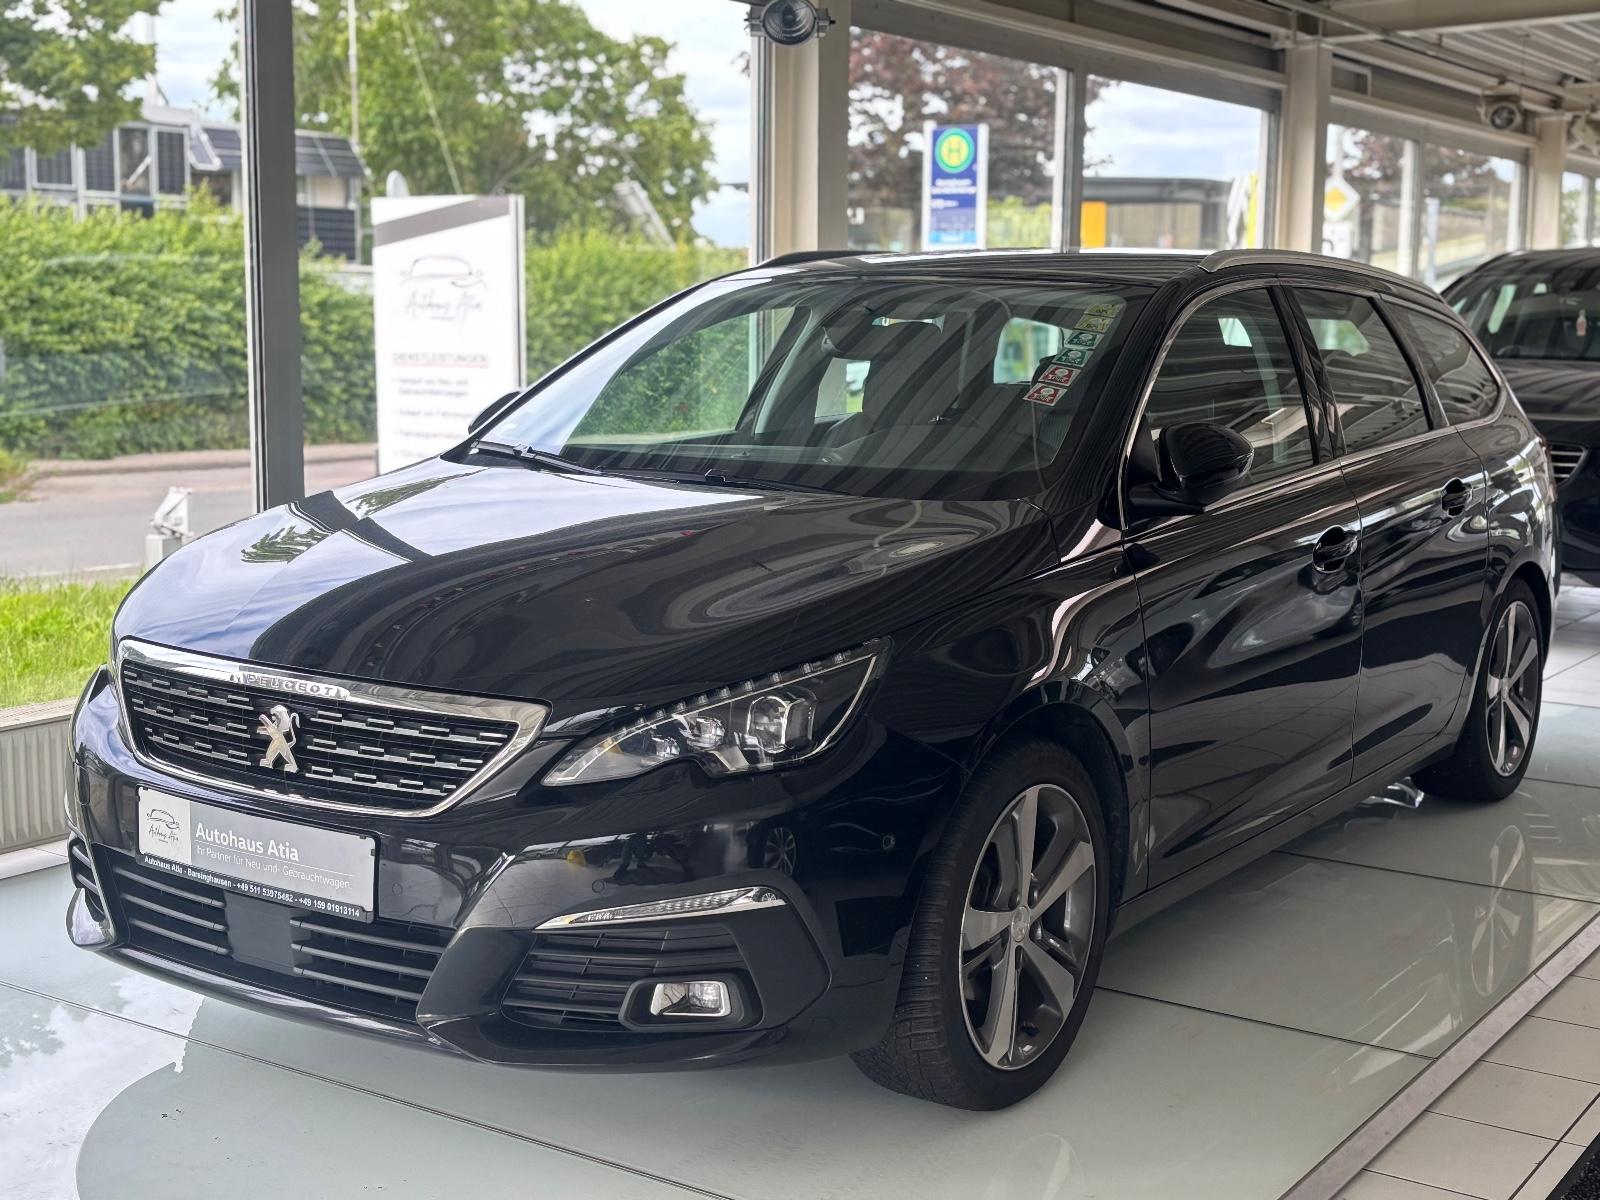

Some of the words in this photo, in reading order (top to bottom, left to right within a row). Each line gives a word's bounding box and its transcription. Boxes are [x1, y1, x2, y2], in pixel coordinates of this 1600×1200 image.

[246, 674, 334, 695] PEUGEOT
[195, 822, 264, 854] Autohaus
[267, 839, 299, 862] Atia
[206, 847, 231, 862] Partner
[233, 854, 244, 866] für
[245, 859, 261, 870] Neu
[144, 856, 171, 870] Autohaus
[187, 868, 232, 888] Barsinghausen
[236, 882, 249, 892] +49
[249, 885, 261, 895] 511
[299, 898, 312, 907] +49
[313, 900, 326, 910] 159
